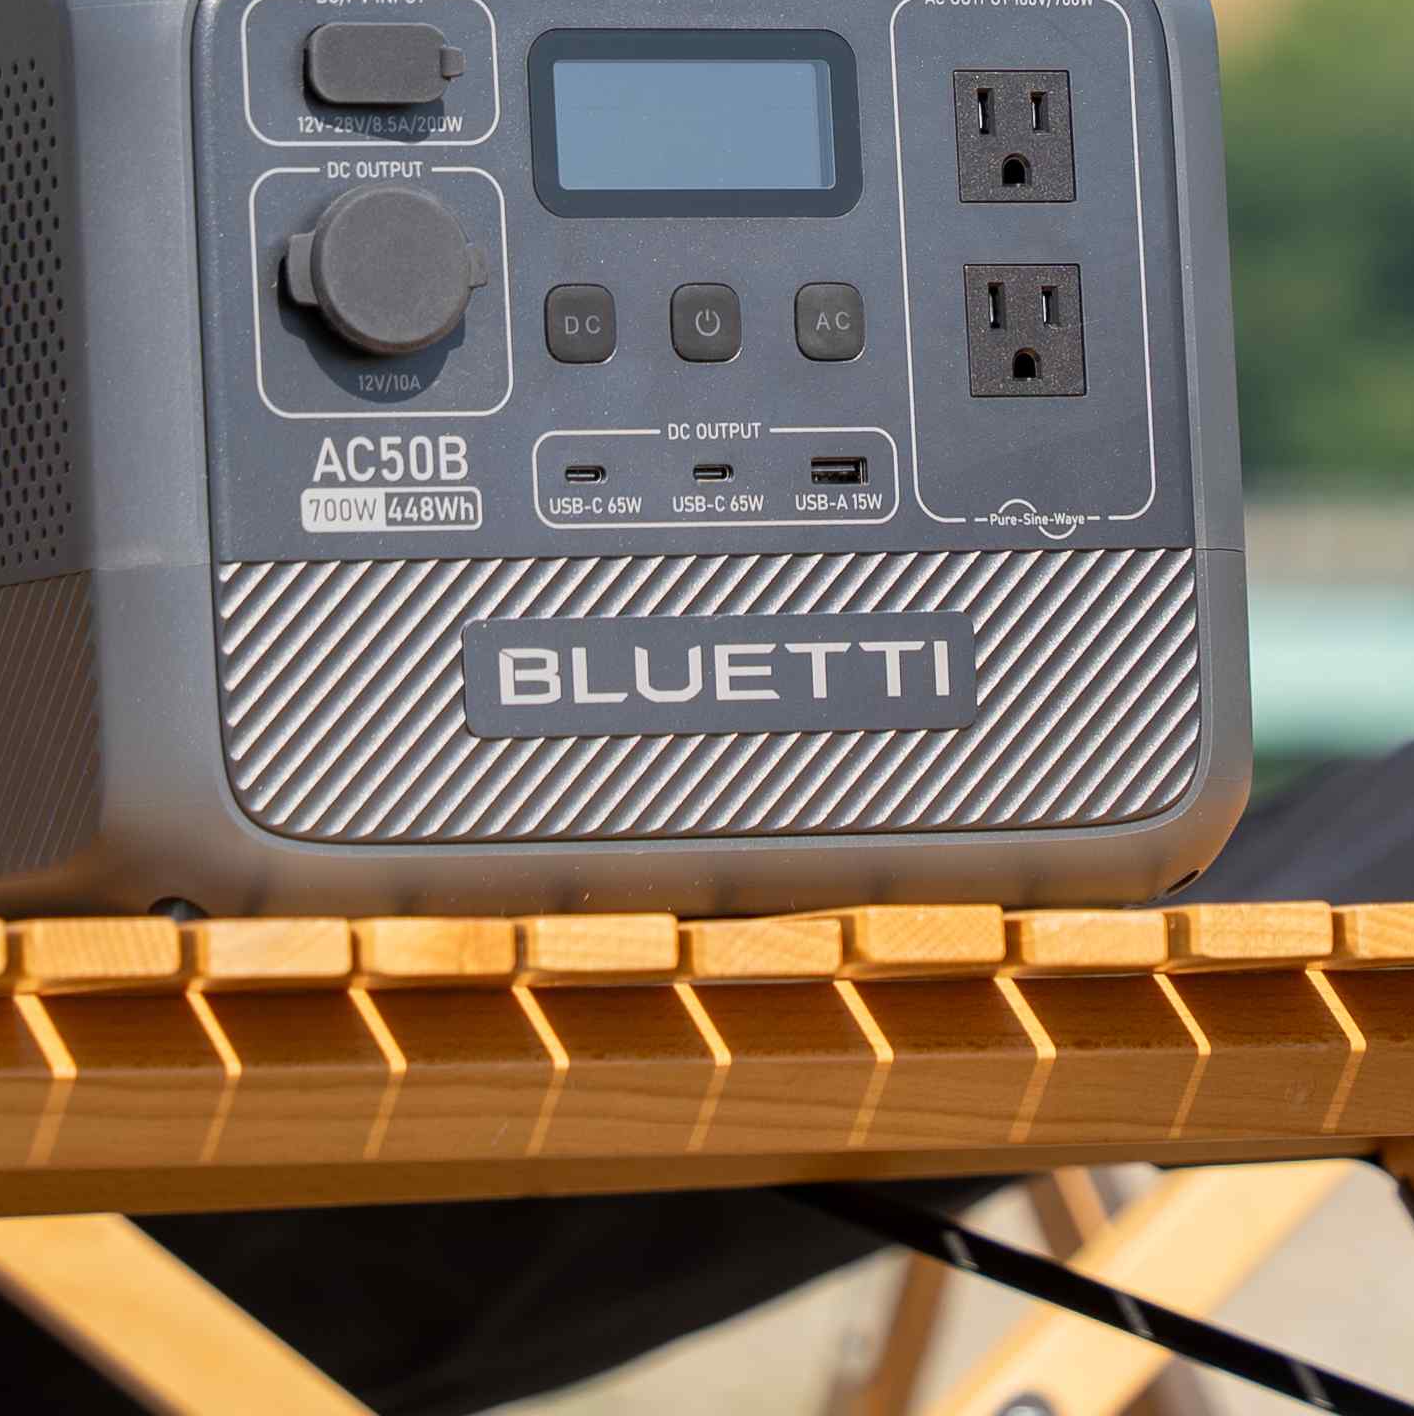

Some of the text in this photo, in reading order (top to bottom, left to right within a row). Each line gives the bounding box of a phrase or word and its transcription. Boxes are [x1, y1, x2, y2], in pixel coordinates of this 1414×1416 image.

[297, 114, 463, 134] 12V-28V/8.5A/200W
[327, 161, 423, 179] DC OUTPUT
[564, 315, 602, 334] DC
[815, 311, 851, 331] AC
[358, 373, 422, 393] 12V/10A
[668, 422, 762, 440] DC OUTPUT
[312, 435, 469, 483] AC50B
[308, 495, 475, 522] 700W 448Wh
[549, 496, 643, 515] USB-C 65W
[672, 494, 764, 513] USB-C 65W
[795, 493, 883, 512] USB-A 15W
[989, 512, 1085, 526] Pure-Sine-Wave
[498, 640, 951, 706] BLUETTI
